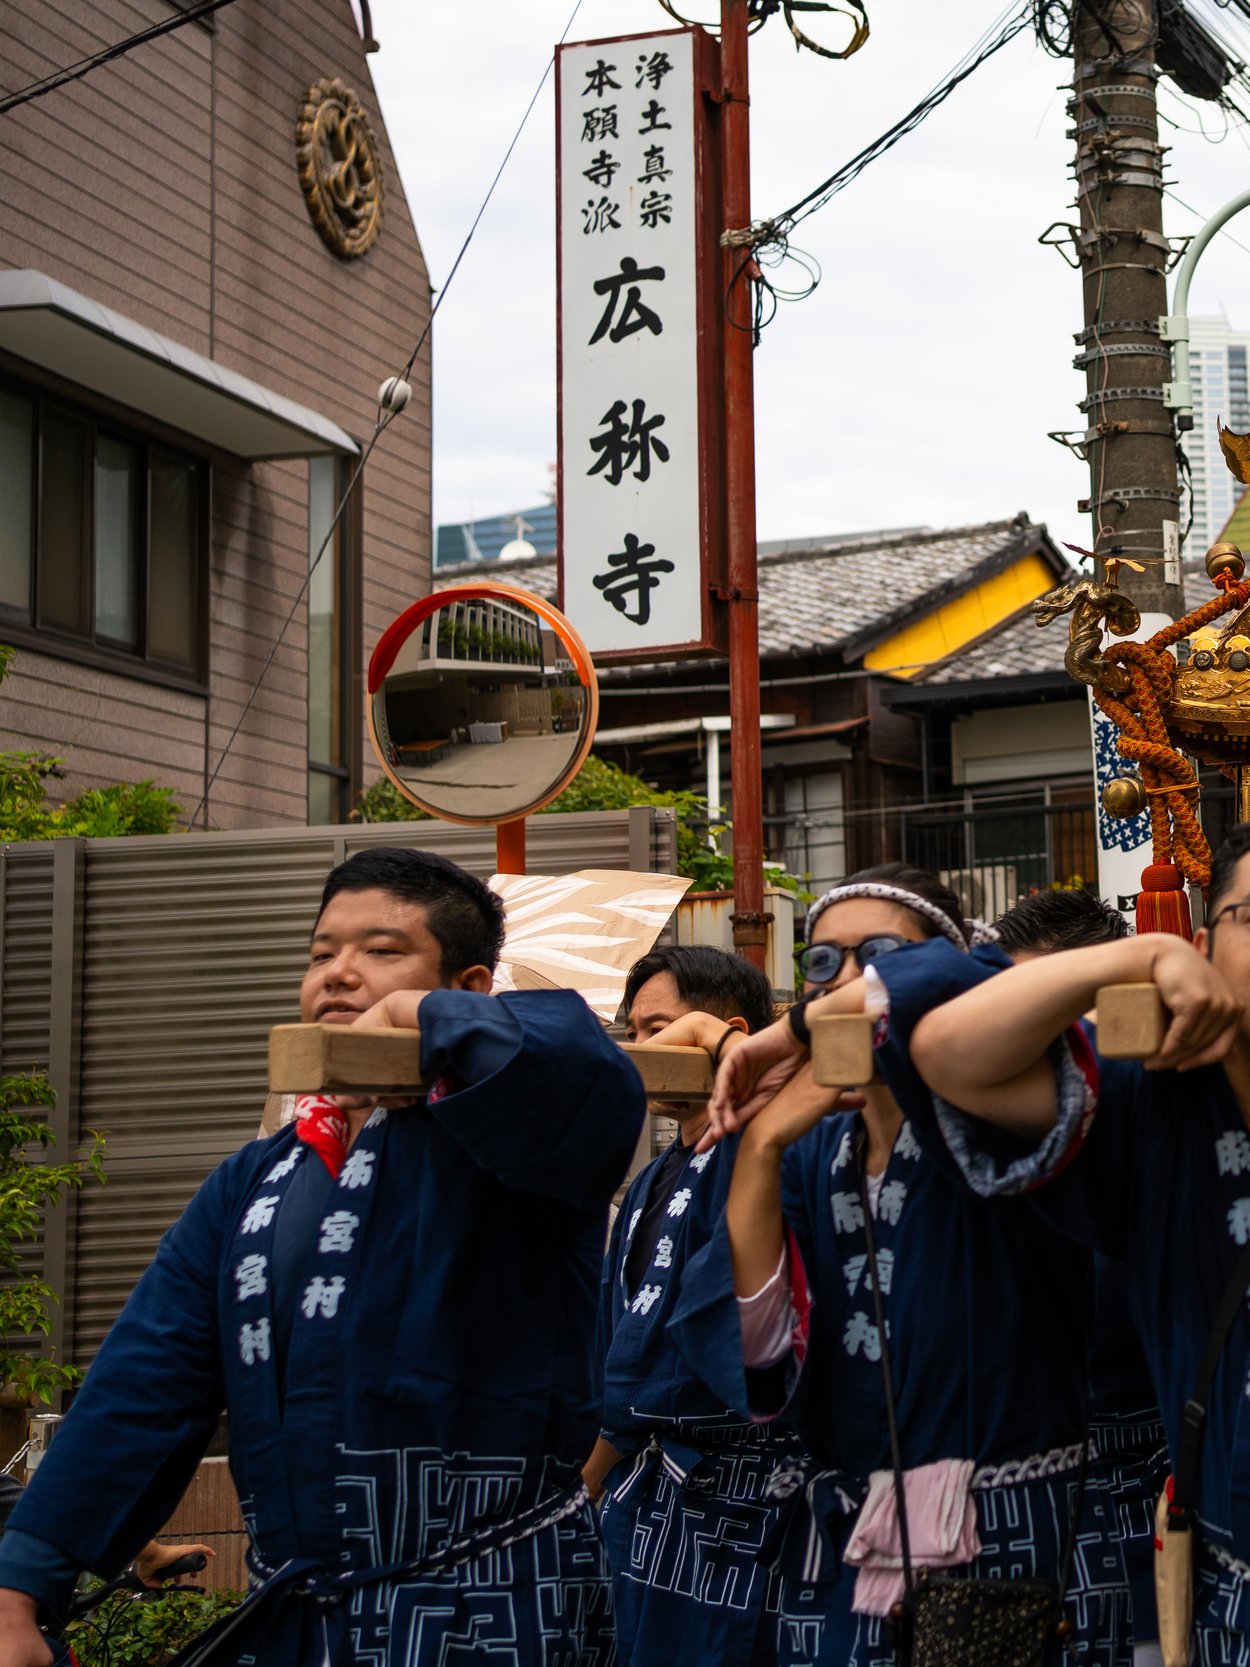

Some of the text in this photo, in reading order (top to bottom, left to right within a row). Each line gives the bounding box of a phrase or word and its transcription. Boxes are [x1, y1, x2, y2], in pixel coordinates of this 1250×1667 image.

[580, 60, 623, 235] 本願寺派
[634, 51, 674, 228] 浄土真宗
[586, 257, 675, 626] 広称寺
